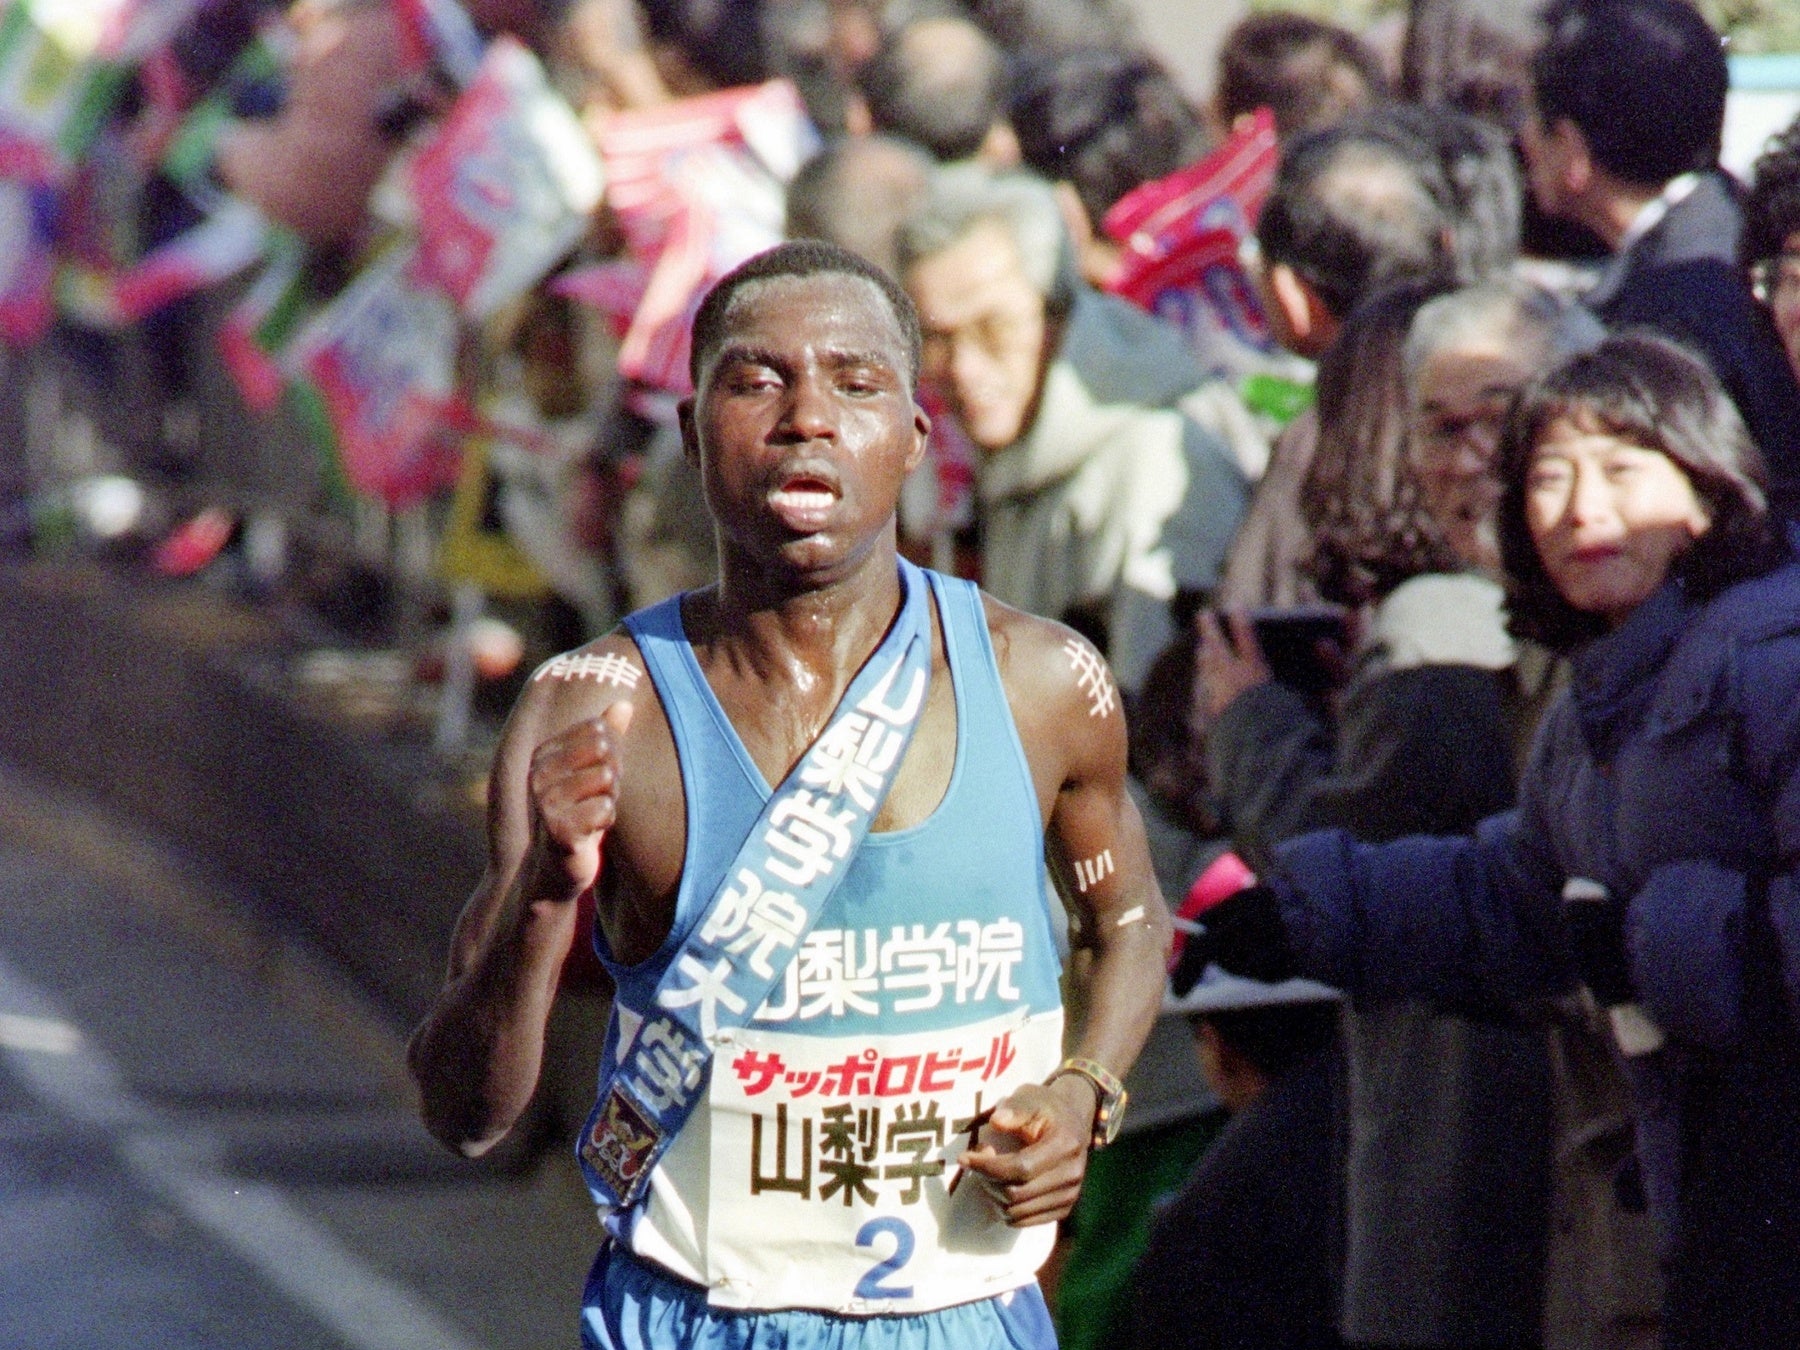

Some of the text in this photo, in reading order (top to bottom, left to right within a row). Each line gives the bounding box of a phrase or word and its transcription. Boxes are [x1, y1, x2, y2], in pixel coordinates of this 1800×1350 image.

[731, 1030, 1017, 1097] サッポロビール
[854, 1216, 915, 1299] 2
